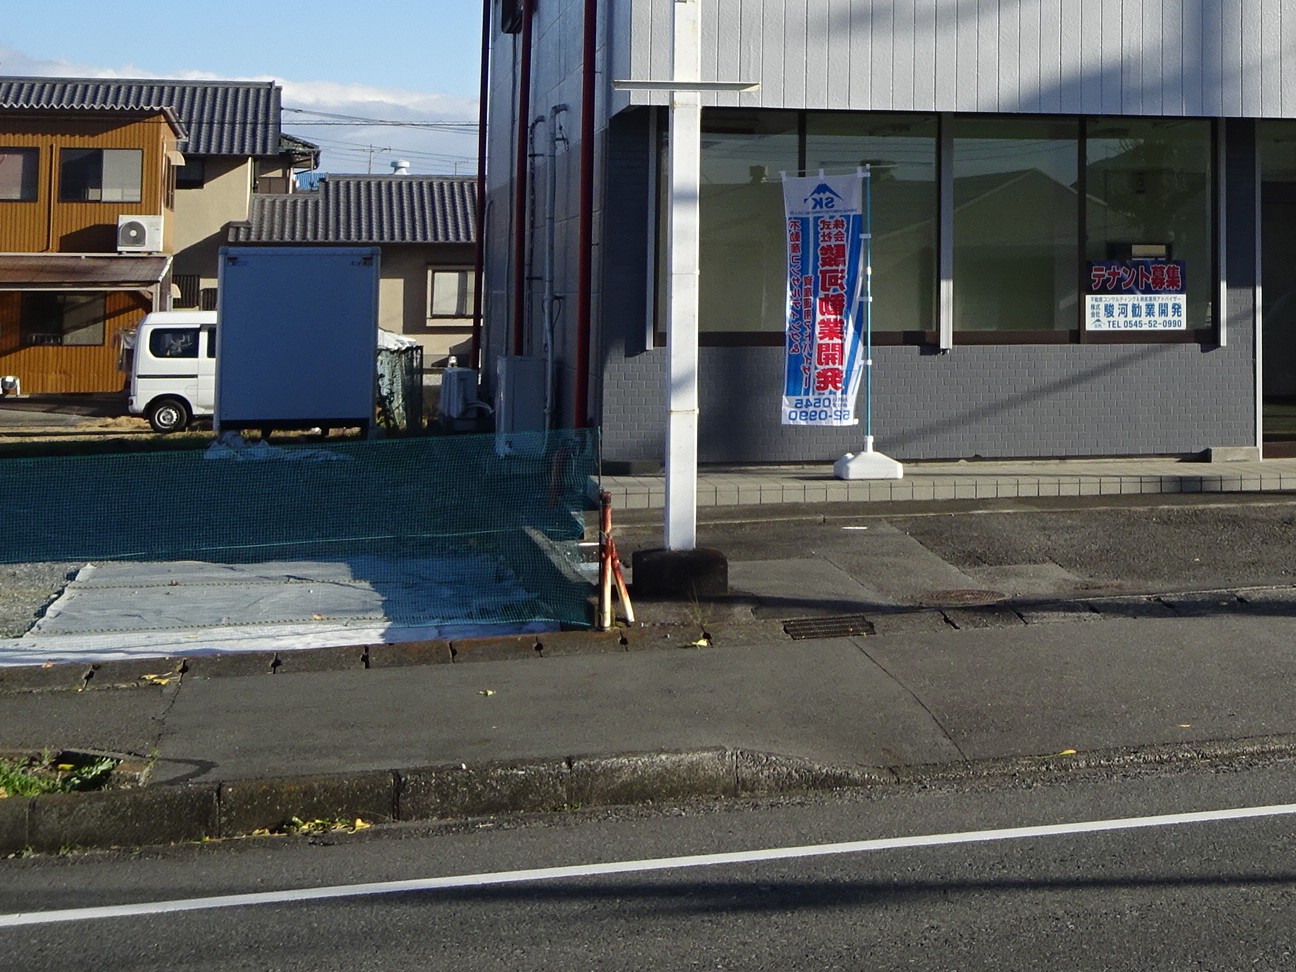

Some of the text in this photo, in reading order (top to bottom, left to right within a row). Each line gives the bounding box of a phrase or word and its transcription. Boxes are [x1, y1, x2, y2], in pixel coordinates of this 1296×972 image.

[1091, 264, 1181, 290] テナント募集
[1103, 303, 1182, 318] 駿河勧業開発
[1107, 320, 1182, 328] TEL 0545-52-0990
